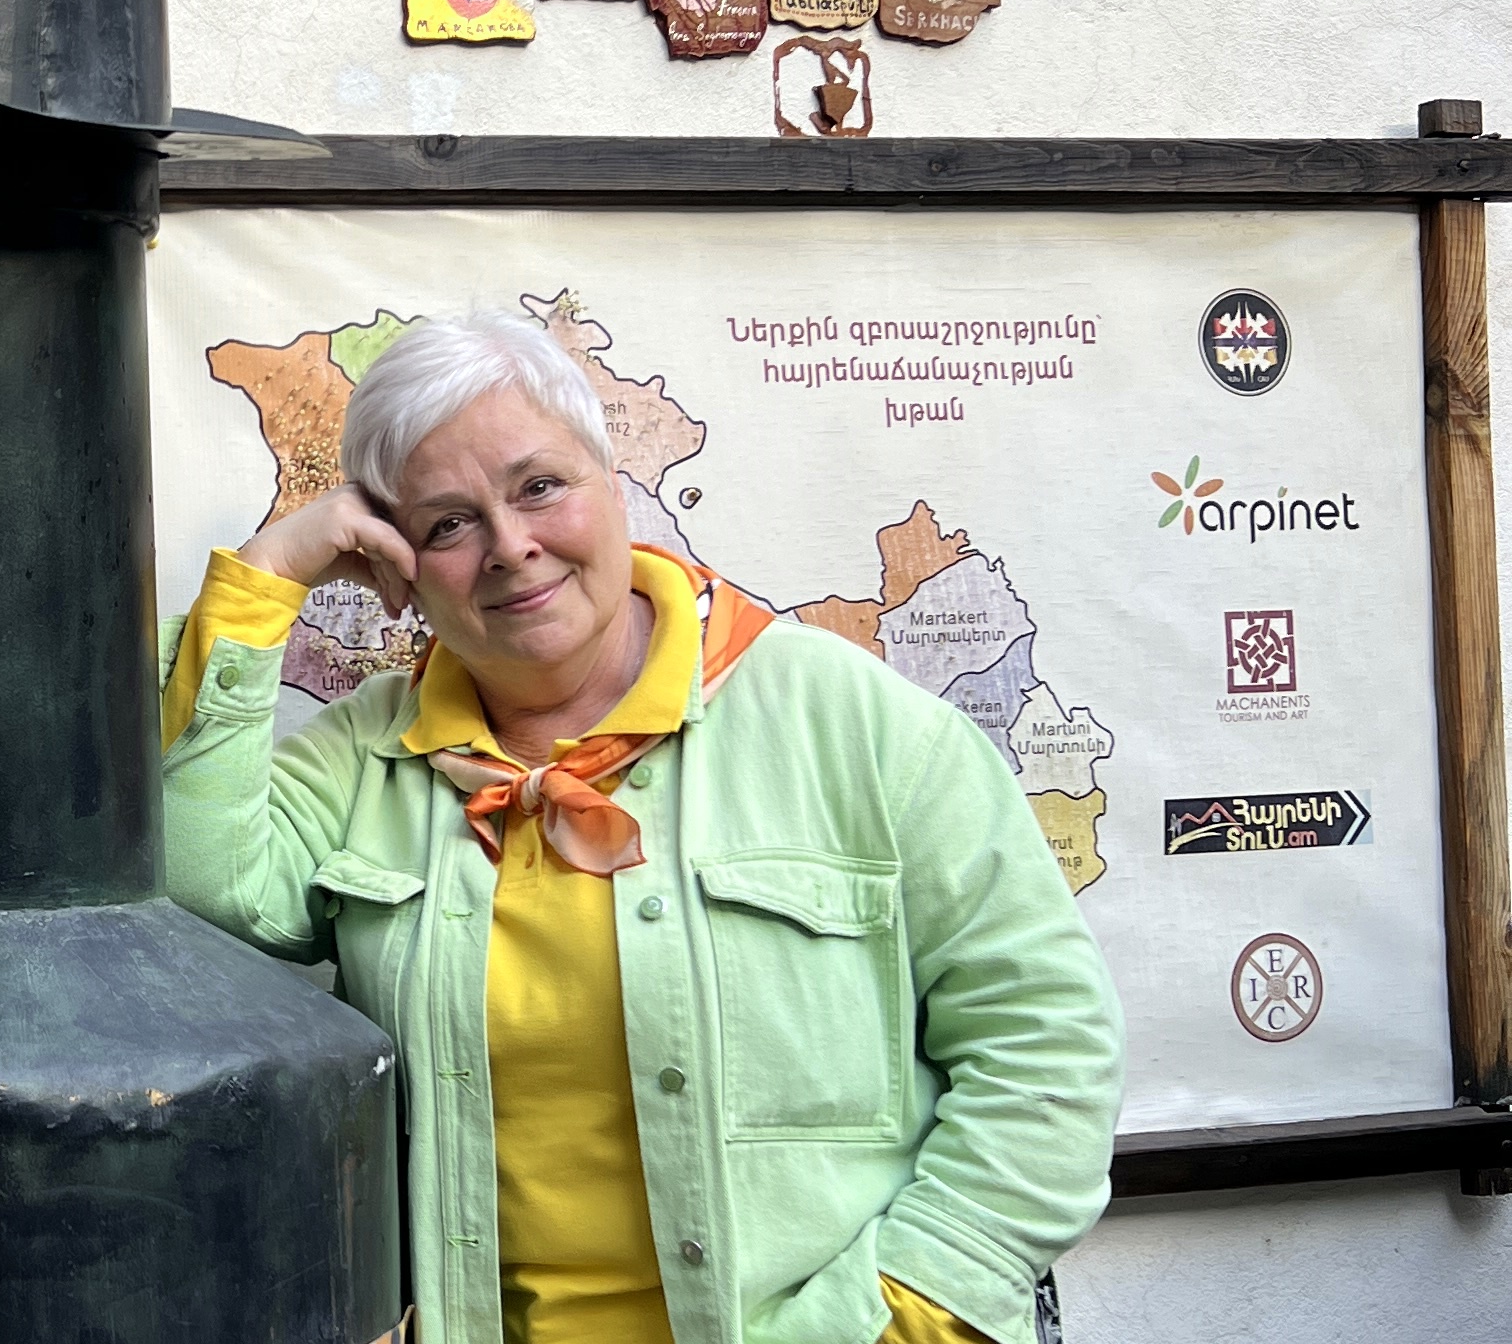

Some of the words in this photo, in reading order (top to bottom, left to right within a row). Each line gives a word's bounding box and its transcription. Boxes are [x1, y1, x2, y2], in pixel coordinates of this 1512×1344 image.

[726, 316, 838, 348] Ներքին
[763, 355, 1073, 388] հայրենաճանաչության
[885, 396, 964, 428] խթան
[1199, 486, 1360, 544] arpinet
[910, 610, 989, 626] Martakert
[891, 627, 1006, 647] Մարտակերտ
[954, 700, 1003, 714] keran
[1215, 694, 1311, 711] MACHANENTS
[1218, 711, 1262, 723] TOURISM
[1264, 710, 1288, 721] AND
[1290, 709, 1309, 720] ART
[1032, 720, 1091, 737] Martuni
[1017, 737, 1106, 758] Մարտունի
